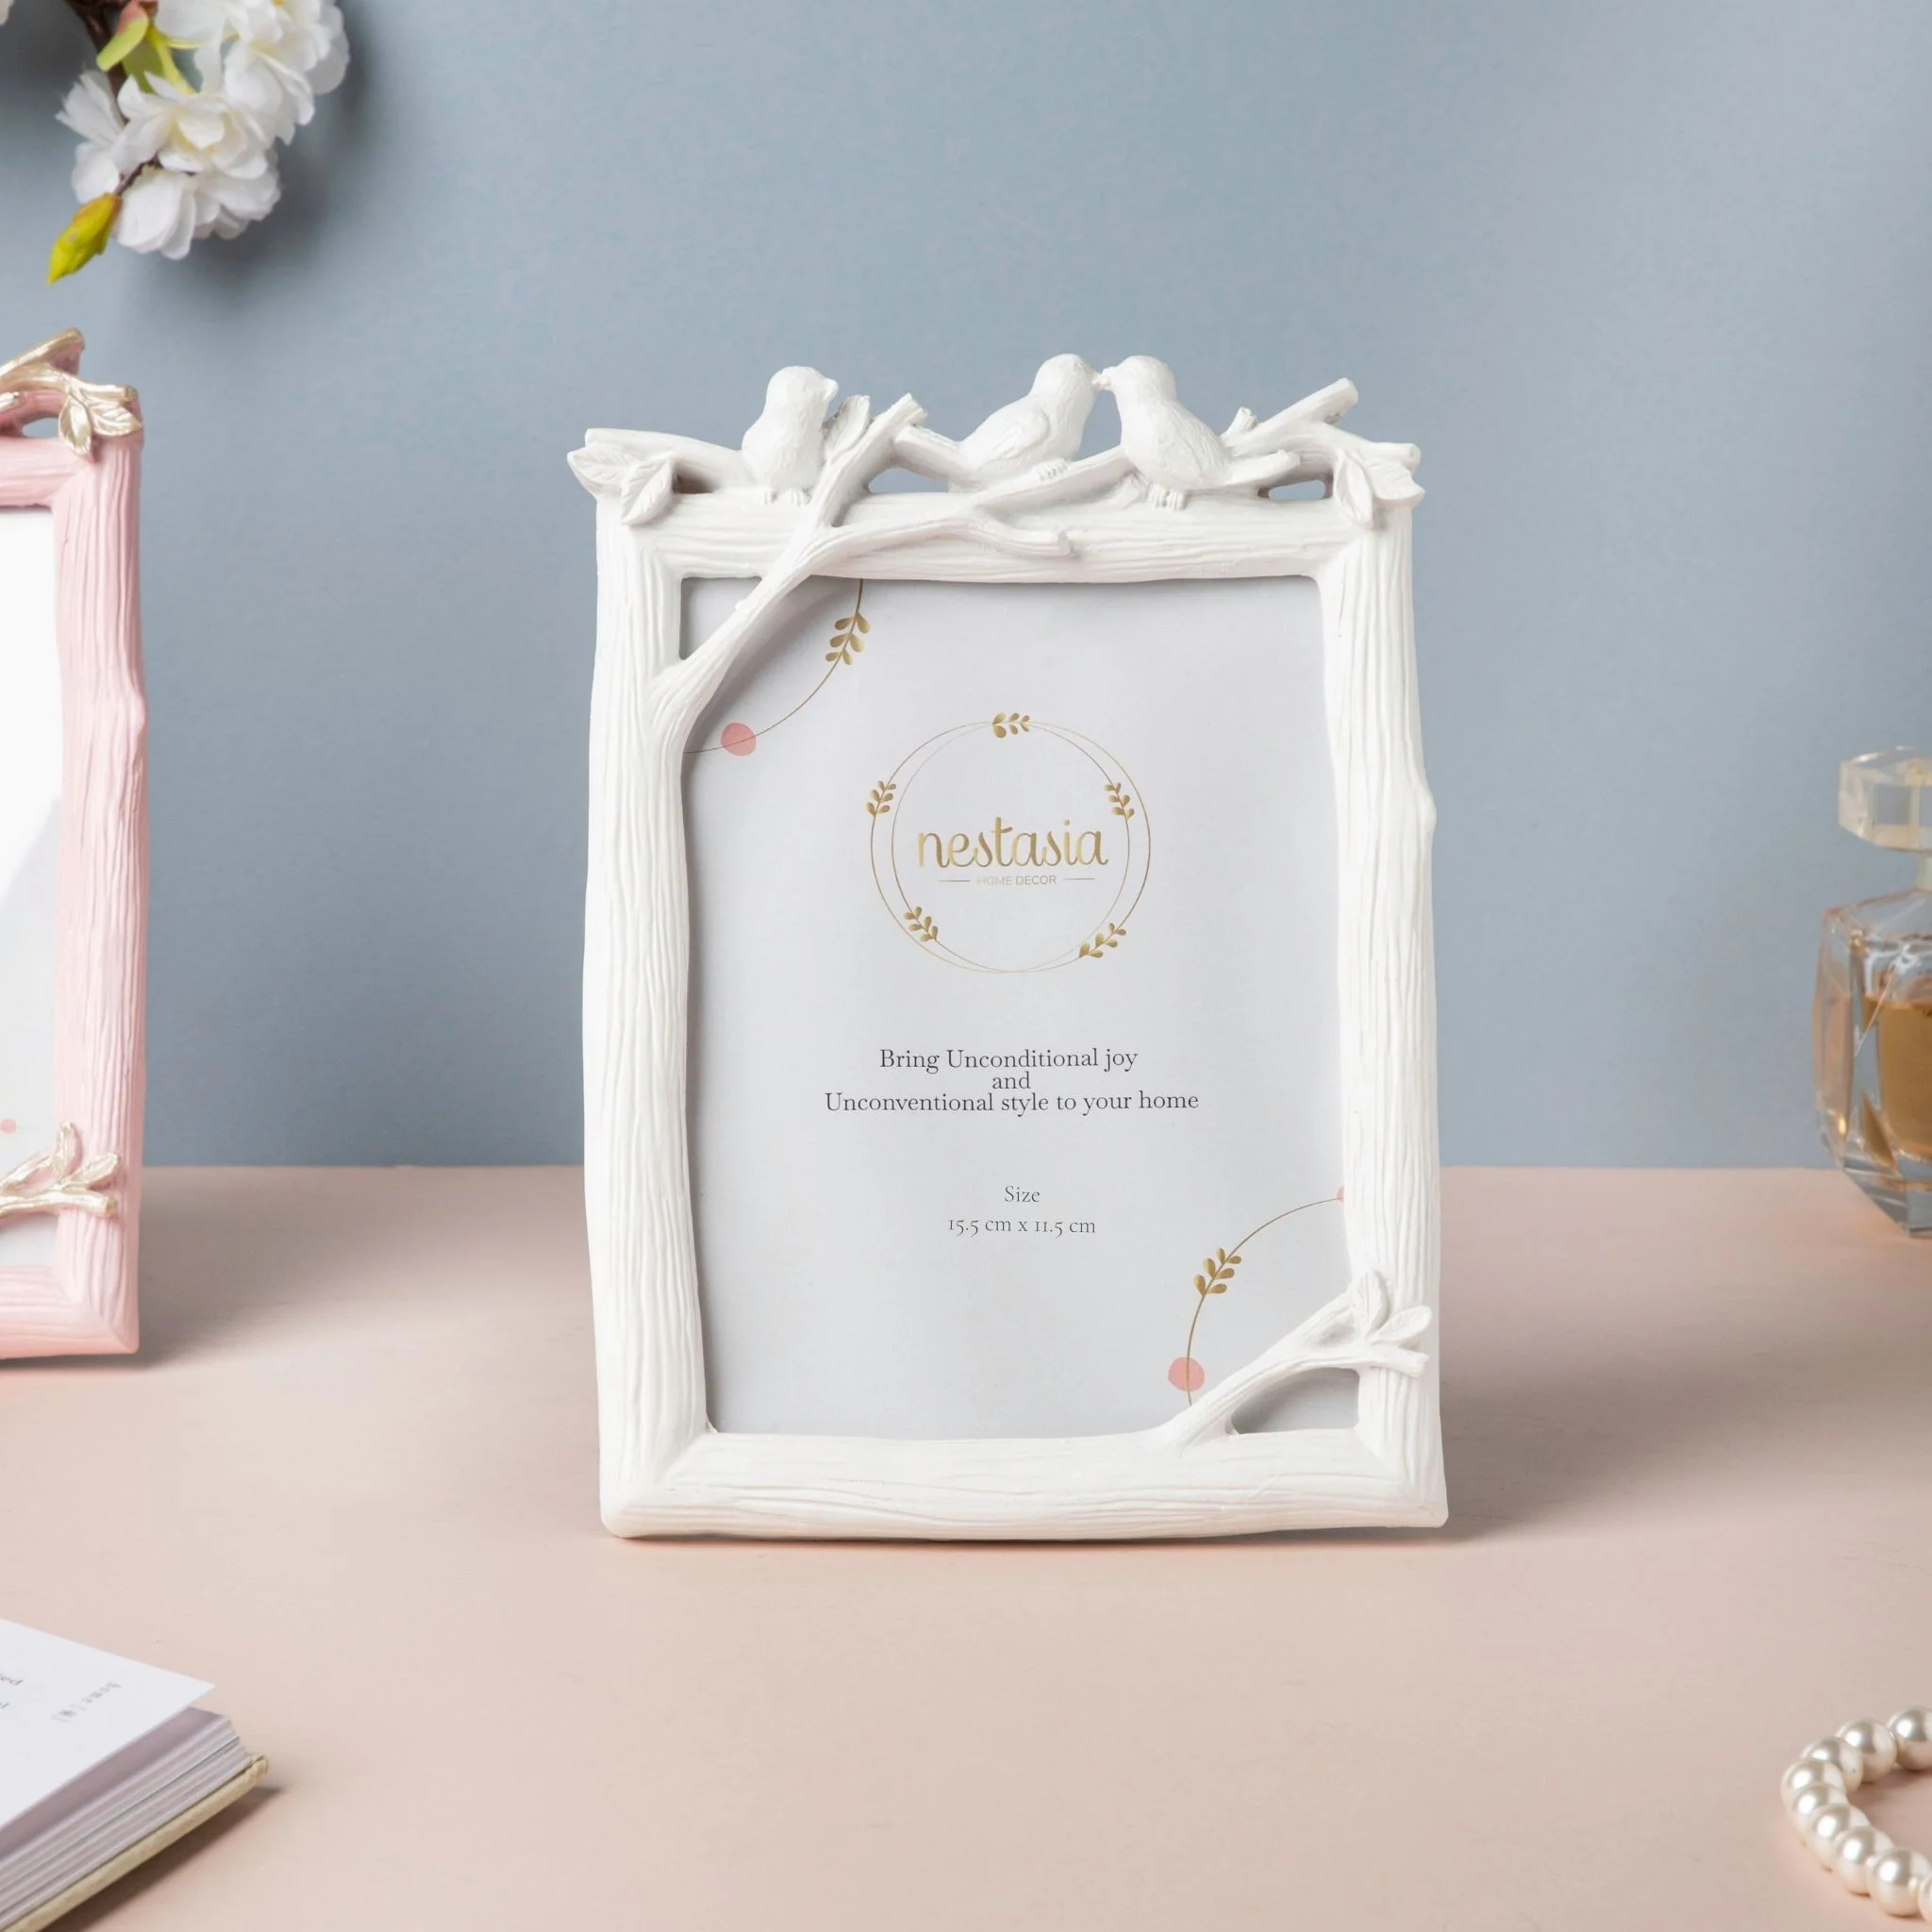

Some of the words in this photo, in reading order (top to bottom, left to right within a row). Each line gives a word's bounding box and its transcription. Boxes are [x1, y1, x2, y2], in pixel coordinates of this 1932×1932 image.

[916, 817, 1109, 869] nestasia
[976, 875, 1013, 887] HOME
[1015, 874, 1058, 886] DECOR
[878, 1049, 940, 1074] Bring
[946, 1048, 1099, 1069] Unconditional
[1103, 1048, 1140, 1073] joy
[991, 1071, 1031, 1090] and
[824, 1092, 994, 1111] Unconventional
[1000, 1092, 1049, 1117] style
[1057, 1095, 1077, 1110] to
[1082, 1097, 1132, 1116] your
[1138, 1090, 1200, 1109] home
[1004, 1185, 1041, 1203] Size
[948, 1218, 980, 1238] 15.5
[985, 1220, 1012, 1232] cm
[1018, 1221, 1029, 1232] x
[1034, 1221, 1064, 1239] 11.5
[1069, 1222, 1096, 1234] cm
